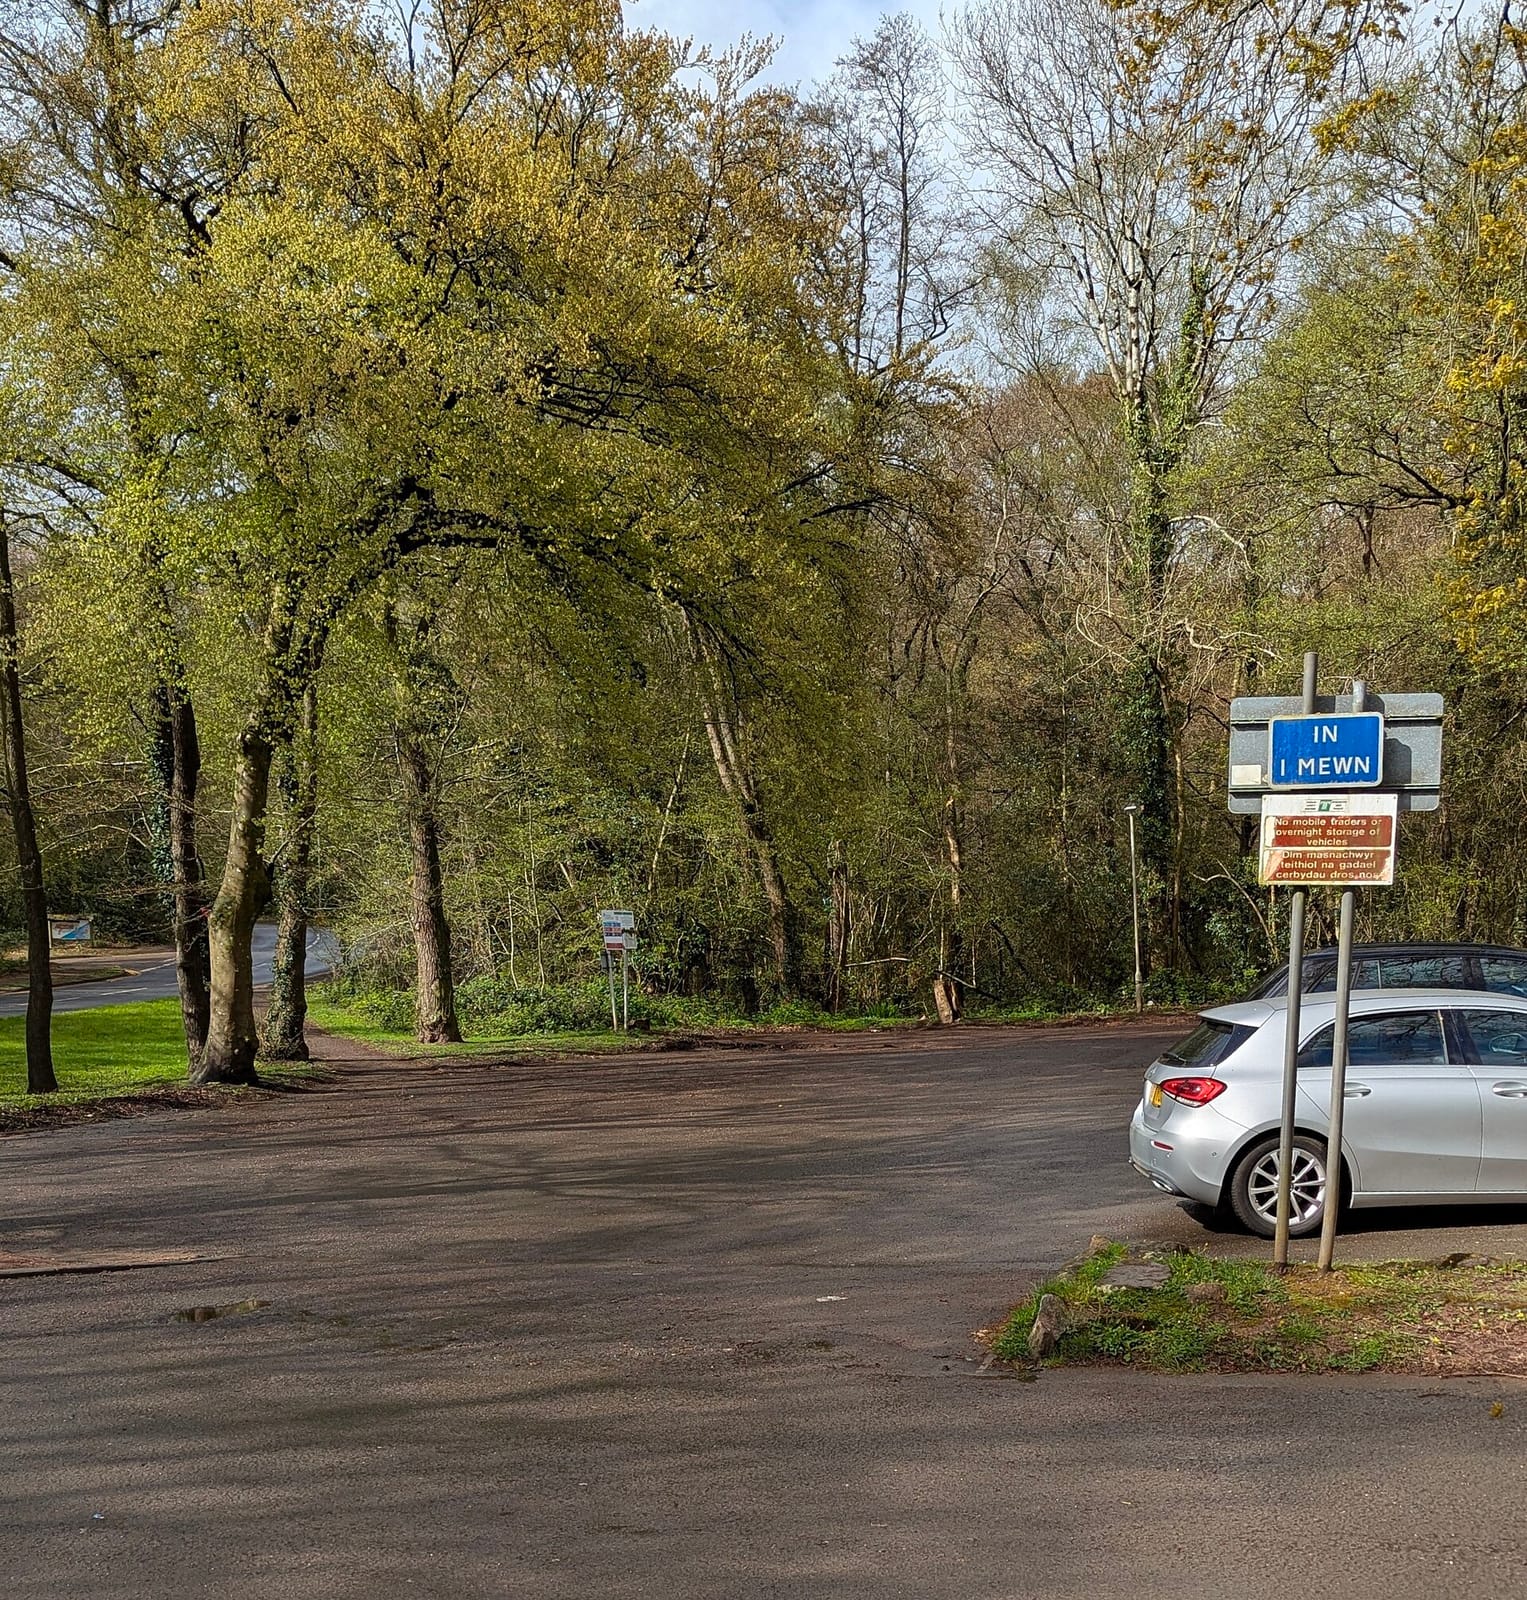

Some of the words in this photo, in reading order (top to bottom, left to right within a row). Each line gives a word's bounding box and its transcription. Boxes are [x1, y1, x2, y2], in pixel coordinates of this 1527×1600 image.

[1314, 725, 1337, 743] IN
[1281, 759, 1285, 776] I
[1298, 757, 1370, 775] MEWN
[1330, 817, 1366, 825] traders
[1276, 828, 1322, 837] overnight
[1327, 828, 1365, 837] storage
[1340, 861, 1376, 870] gadael
[1276, 871, 1325, 880] cerbydau
